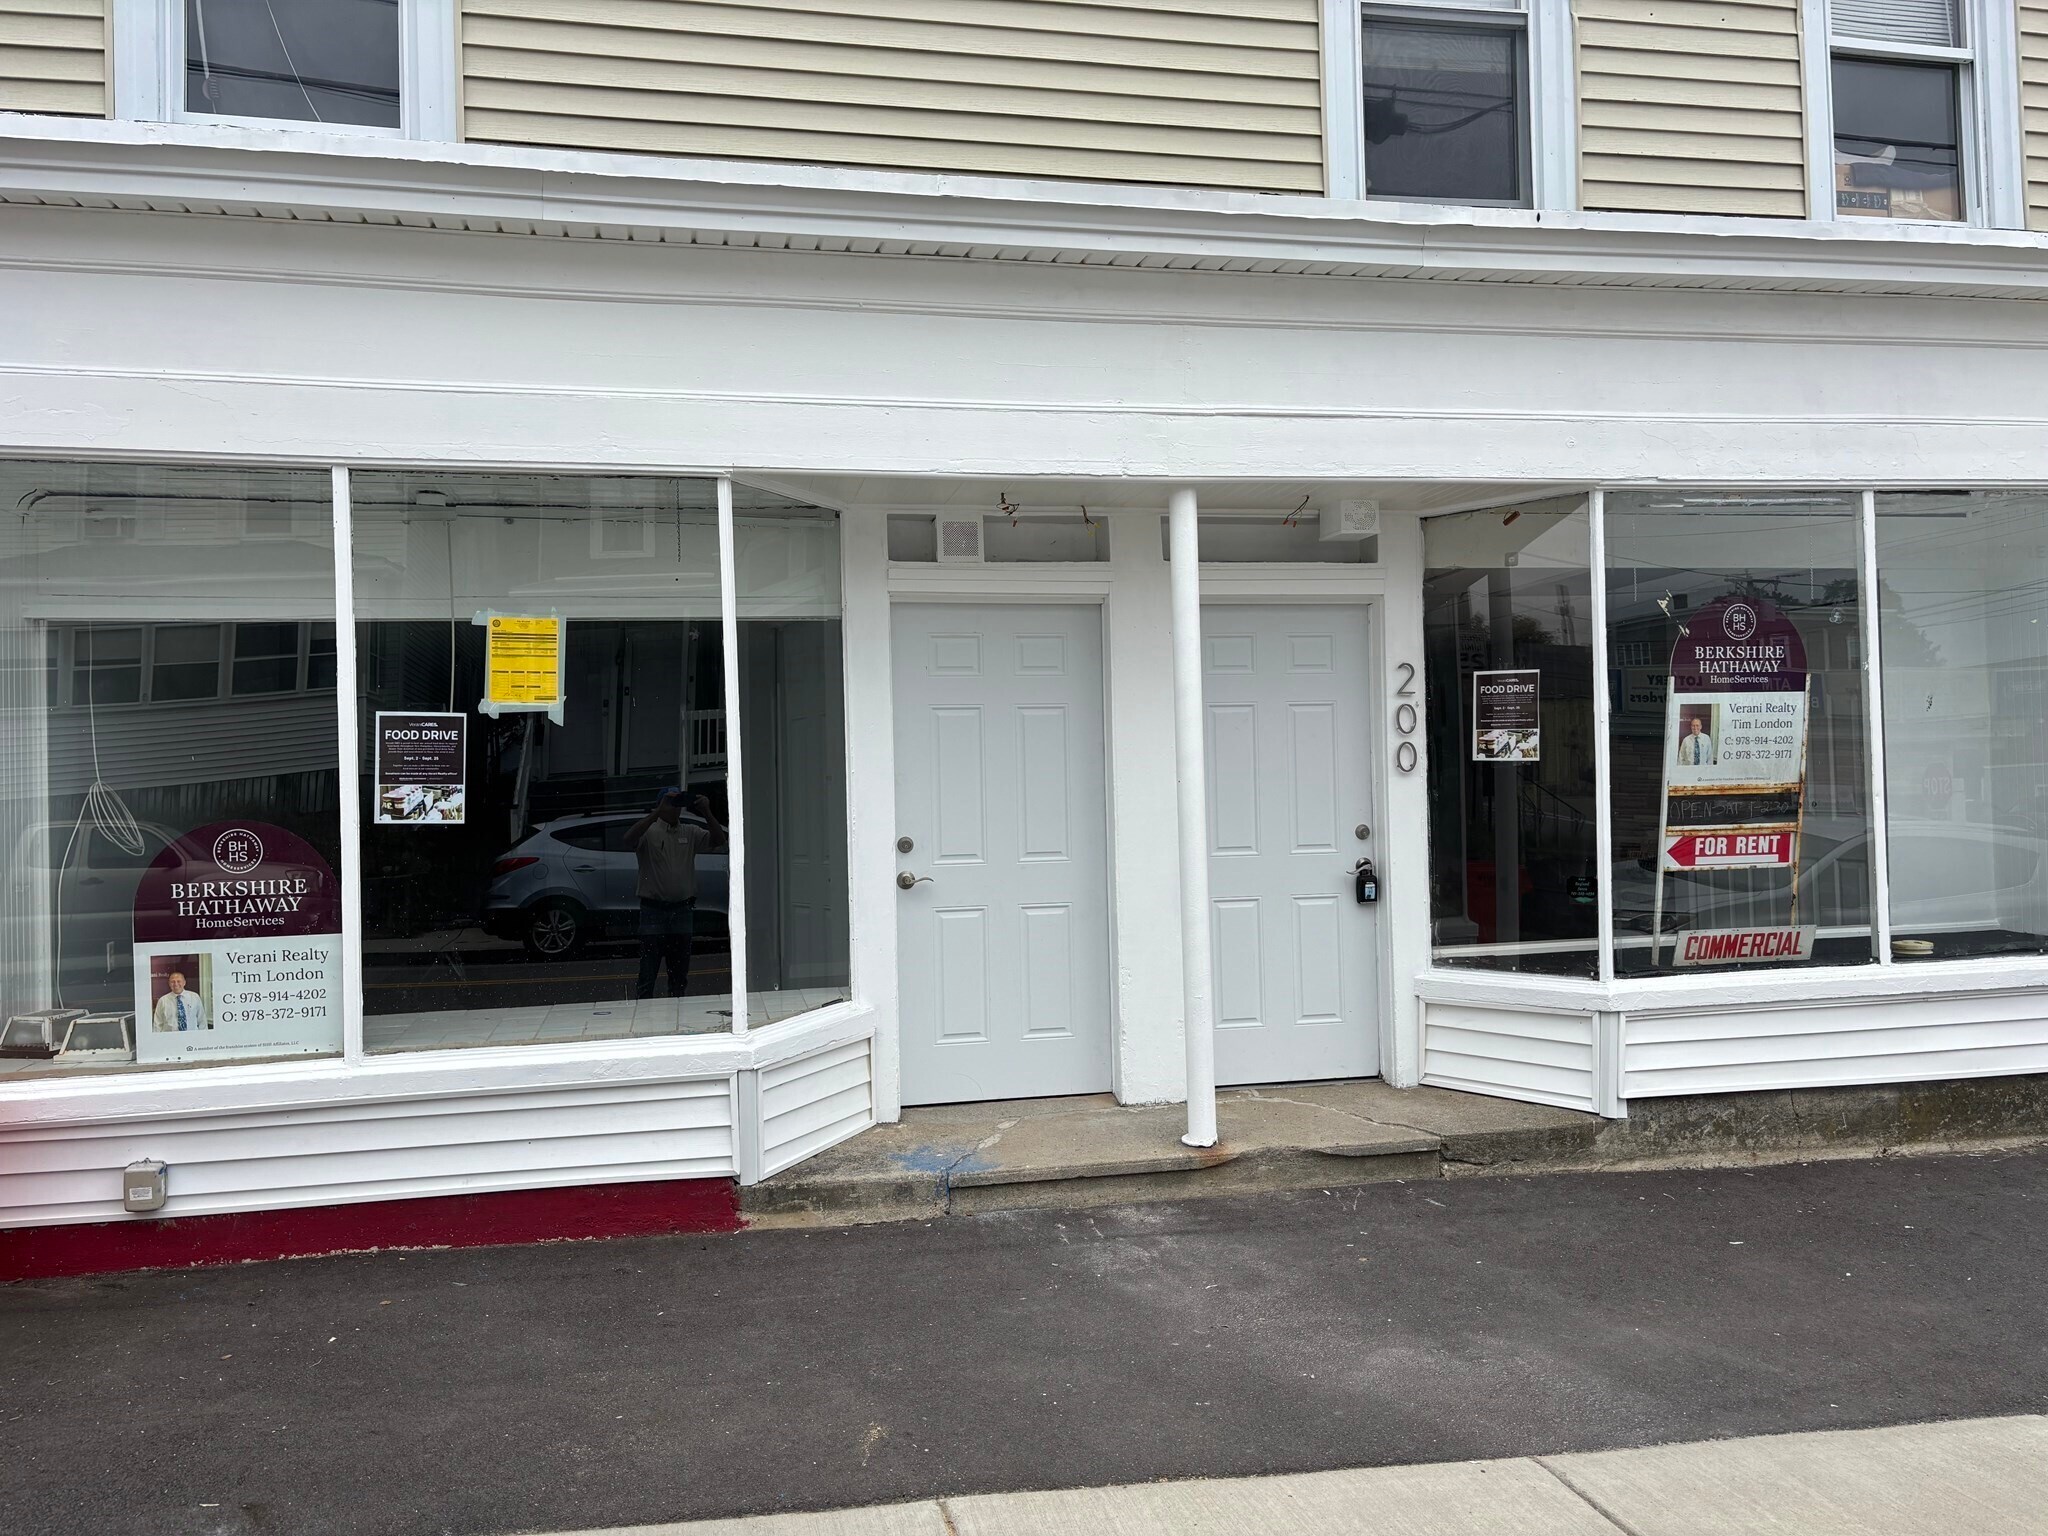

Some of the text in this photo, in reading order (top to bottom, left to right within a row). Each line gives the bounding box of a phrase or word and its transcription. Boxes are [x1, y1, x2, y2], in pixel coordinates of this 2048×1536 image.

[1733, 613, 1746, 622] BH
[1733, 622, 1746, 631] HS
[1695, 646, 1785, 659] BERKSHIRE
[1700, 660, 1781, 674] HATHAWAY
[1710, 674, 1768, 684] HomeServices
[1480, 684, 1534, 694] FOOD DRIVE
[1729, 702, 1797, 716] Verani Realty
[1396, 662, 1417, 773] 200
[1732, 718, 1792, 729] Tim London
[385, 730, 458, 740] FOOD DRIVE
[1725, 736, 1793, 746] C: 978-914-4202
[1723, 750, 1792, 760] O: 978-372-9171
[228, 840, 248, 851] BH
[1695, 836, 1780, 856] FOR RENT
[229, 851, 248, 862] HS
[170, 878, 308, 900] BERKSHIRE
[178, 896, 302, 917] HATHAWAY
[196, 916, 285, 929] HomeServices
[1684, 931, 1802, 960] COMMERCIAL
[226, 948, 329, 965] Verani Realty
[232, 968, 324, 984] Tim London
[222, 988, 327, 1004] C: 978-914-4202
[222, 1006, 327, 1022] O: 978-372-9171
